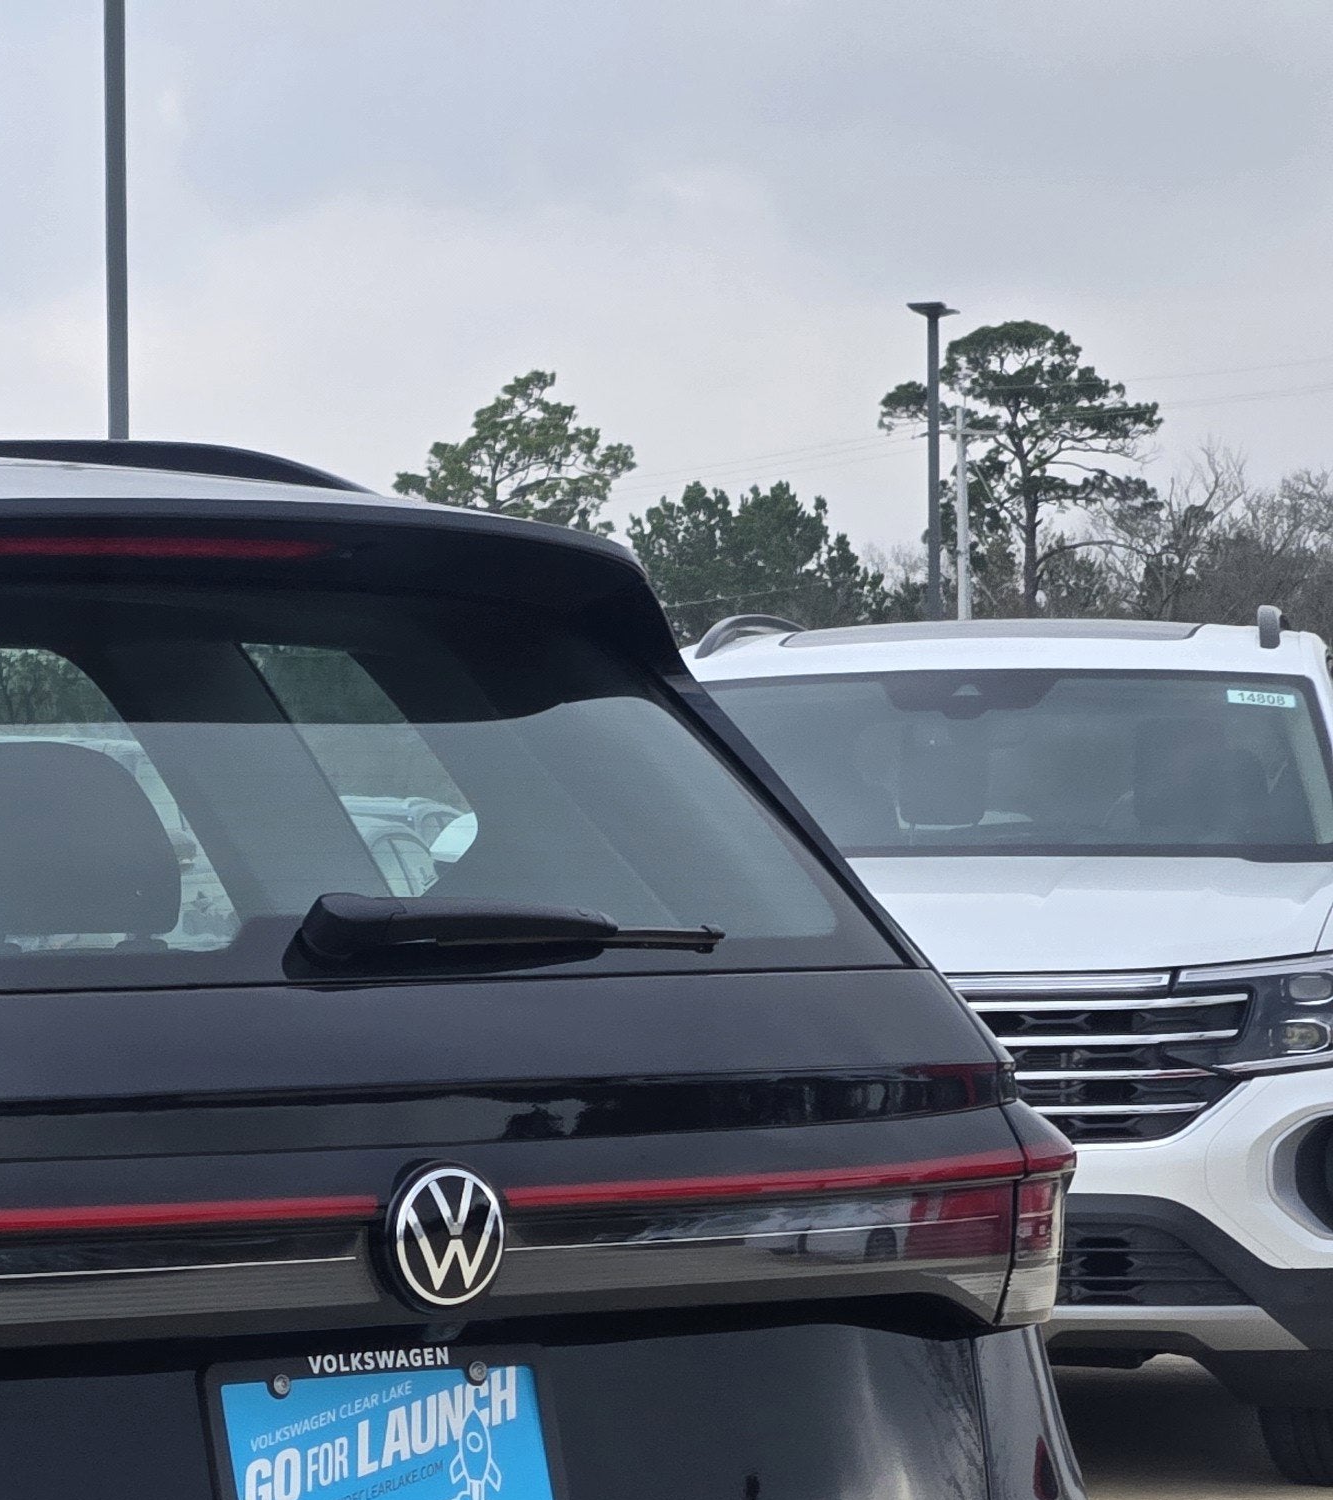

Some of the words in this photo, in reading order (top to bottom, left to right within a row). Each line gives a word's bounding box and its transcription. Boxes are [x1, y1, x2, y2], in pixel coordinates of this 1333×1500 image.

[398, 1171, 503, 1302] VW
[308, 1346, 449, 1375] VOLKSWAGEN
[250, 1410, 337, 1452] VOLKSWAGEN
[339, 1392, 379, 1421] CLEAR
[382, 1380, 413, 1404] LAKE
[306, 1437, 348, 1492] FOR
[356, 1365, 517, 1479] LAUNCH
